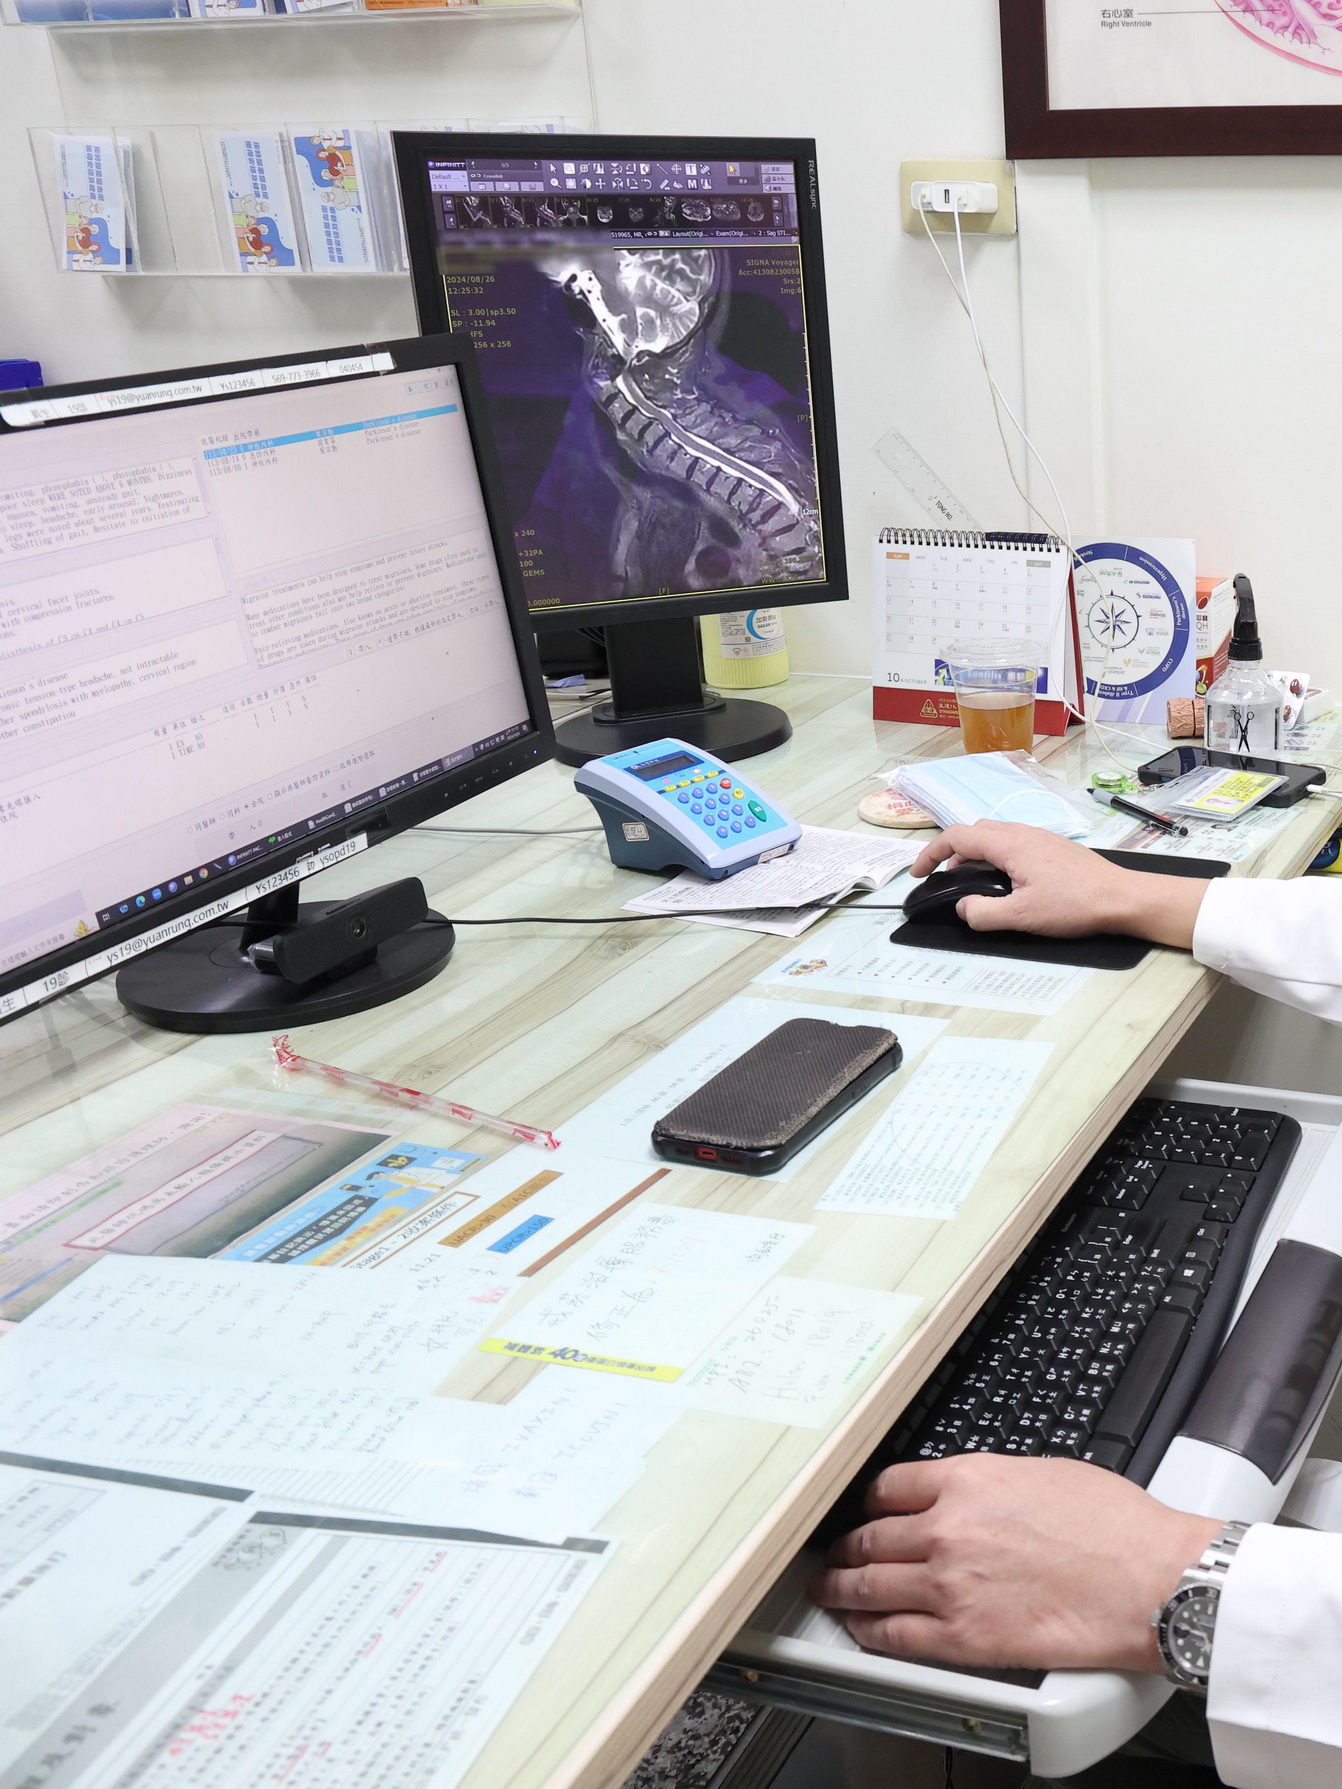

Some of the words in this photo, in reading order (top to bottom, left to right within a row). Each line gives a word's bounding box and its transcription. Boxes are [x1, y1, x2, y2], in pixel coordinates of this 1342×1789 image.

[1101, 8, 1134, 18] 右心室
[1101, 21, 1120, 29] Right
[339, 363, 363, 373] 040454
[219, 377, 256, 390] Ys123456
[272, 371, 321, 384] 569-773-3966
[108, 385, 202, 408] ys19@yuanrung.com.tw
[1139, 556, 1167, 582] Hypertension
[1173, 596, 1182, 627] Parkinson's
[1162, 658, 1174, 672] COPD
[37, 672, 67, 686] disease
[887, 672, 900, 682] 10
[22, 710, 75, 733] constipation
[320, 841, 356, 867] ysopd19
[256, 866, 300, 894] Ys123456
[106, 900, 229, 964] ys19@yuanrung.com.tw
[43, 970, 70, 992] 19診
